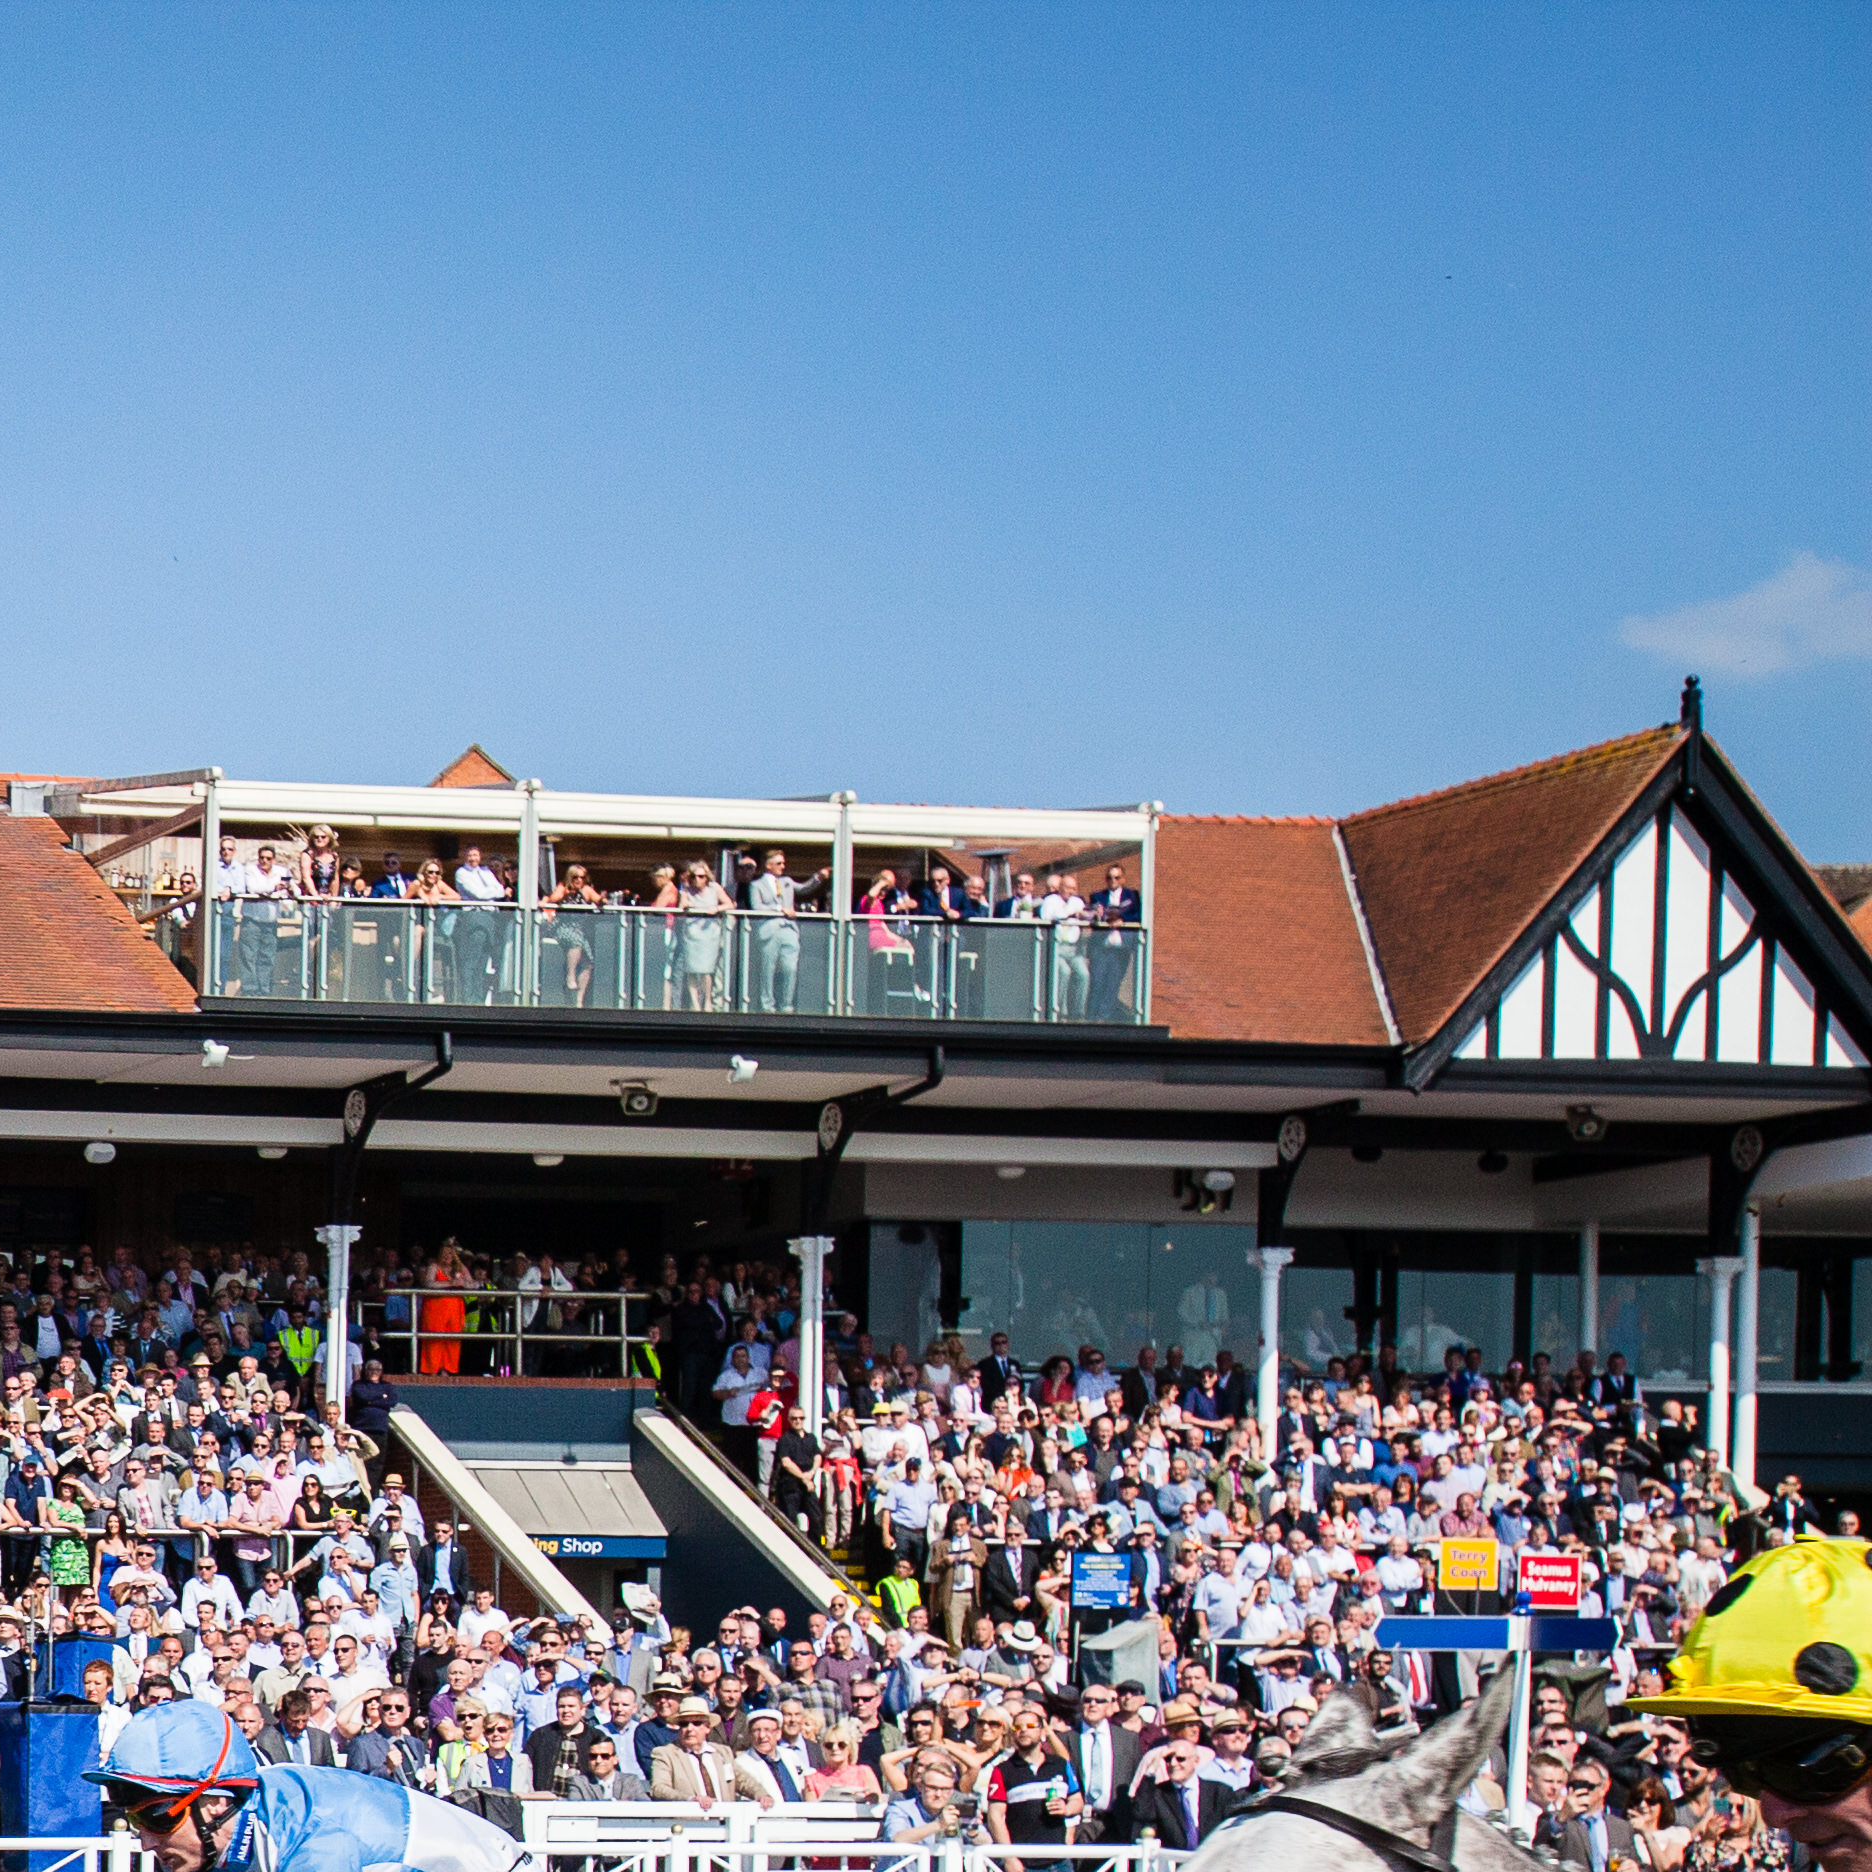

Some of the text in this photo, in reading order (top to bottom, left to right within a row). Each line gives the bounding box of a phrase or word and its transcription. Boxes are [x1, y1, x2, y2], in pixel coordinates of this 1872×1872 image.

[562, 1537, 603, 1555] Shop
[1450, 1549, 1488, 1564] Terry
[1527, 1560, 1572, 1577] Seamus
[1521, 1576, 1577, 1596] Mulvaney
